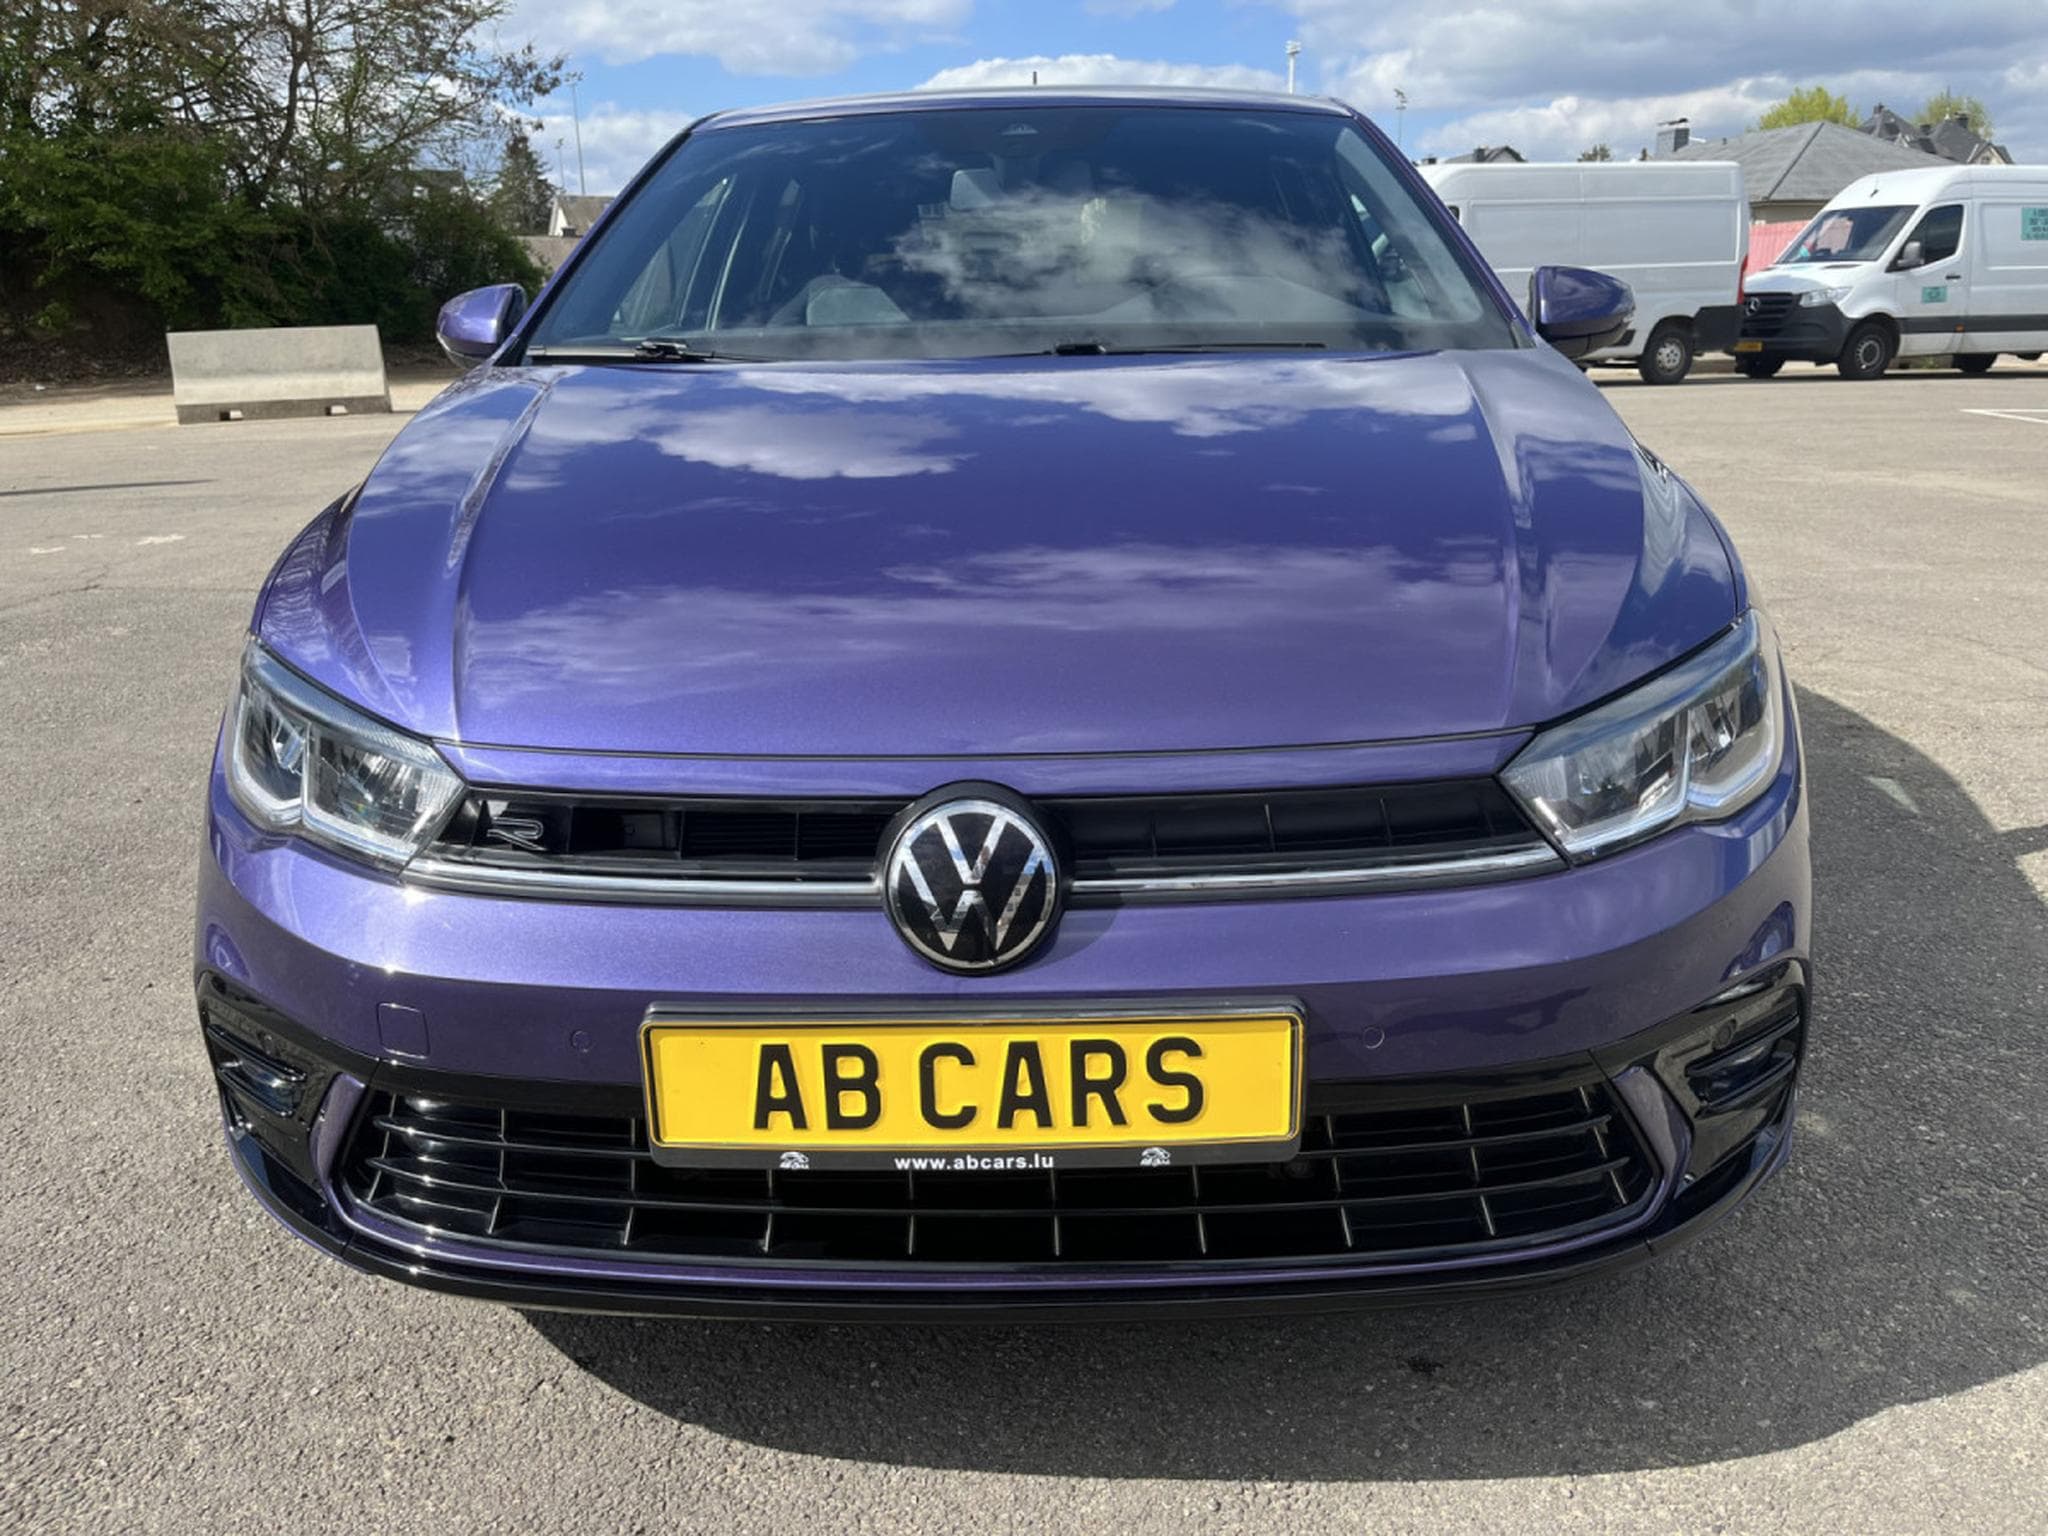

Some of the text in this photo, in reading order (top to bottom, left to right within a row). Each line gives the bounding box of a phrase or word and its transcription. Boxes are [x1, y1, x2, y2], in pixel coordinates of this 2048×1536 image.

[893, 803, 1051, 960] VW
[754, 1037, 1205, 1130] AB CARS
[894, 1153, 1054, 1170] www.abcars.lu
